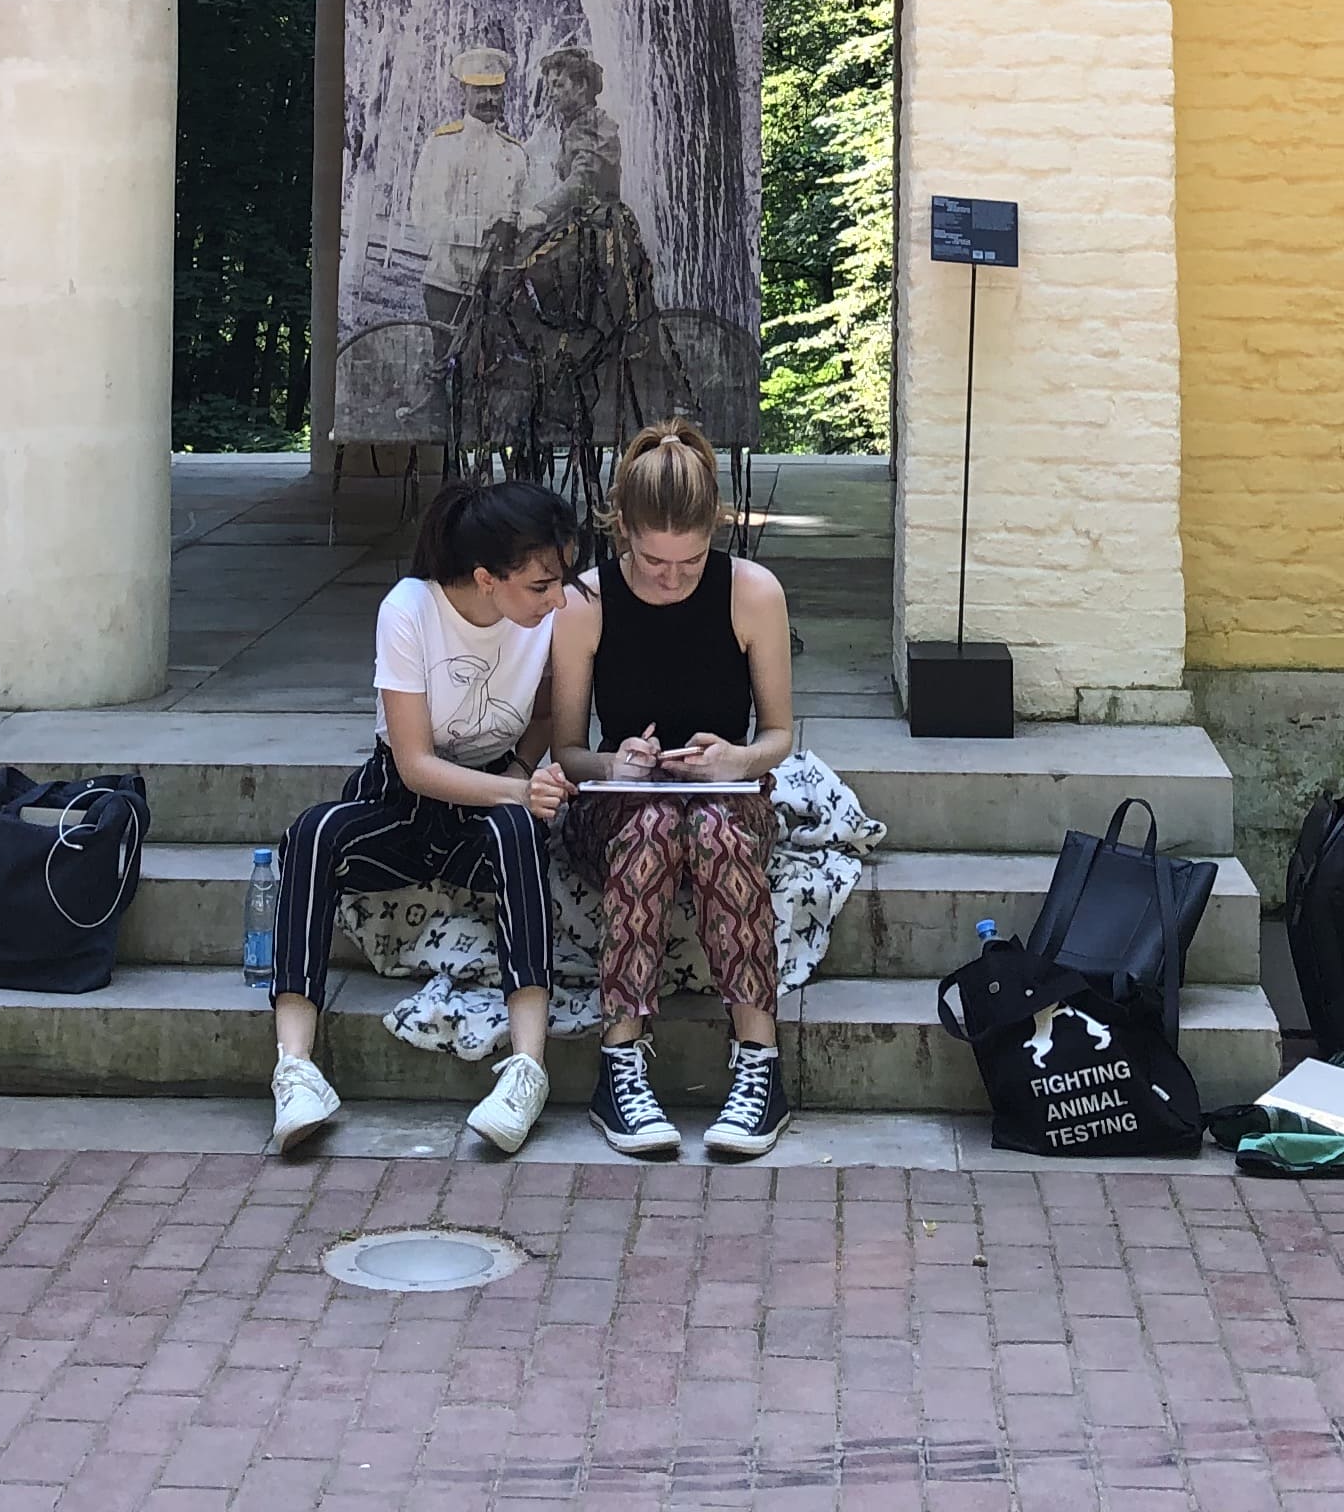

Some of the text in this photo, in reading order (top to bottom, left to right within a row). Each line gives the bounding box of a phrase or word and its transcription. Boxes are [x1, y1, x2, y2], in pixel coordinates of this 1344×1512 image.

[1030, 1060, 1131, 1097] FIGHTING
[1047, 1089, 1128, 1122] ANIMAL
[1045, 1113, 1138, 1148] TESTING
